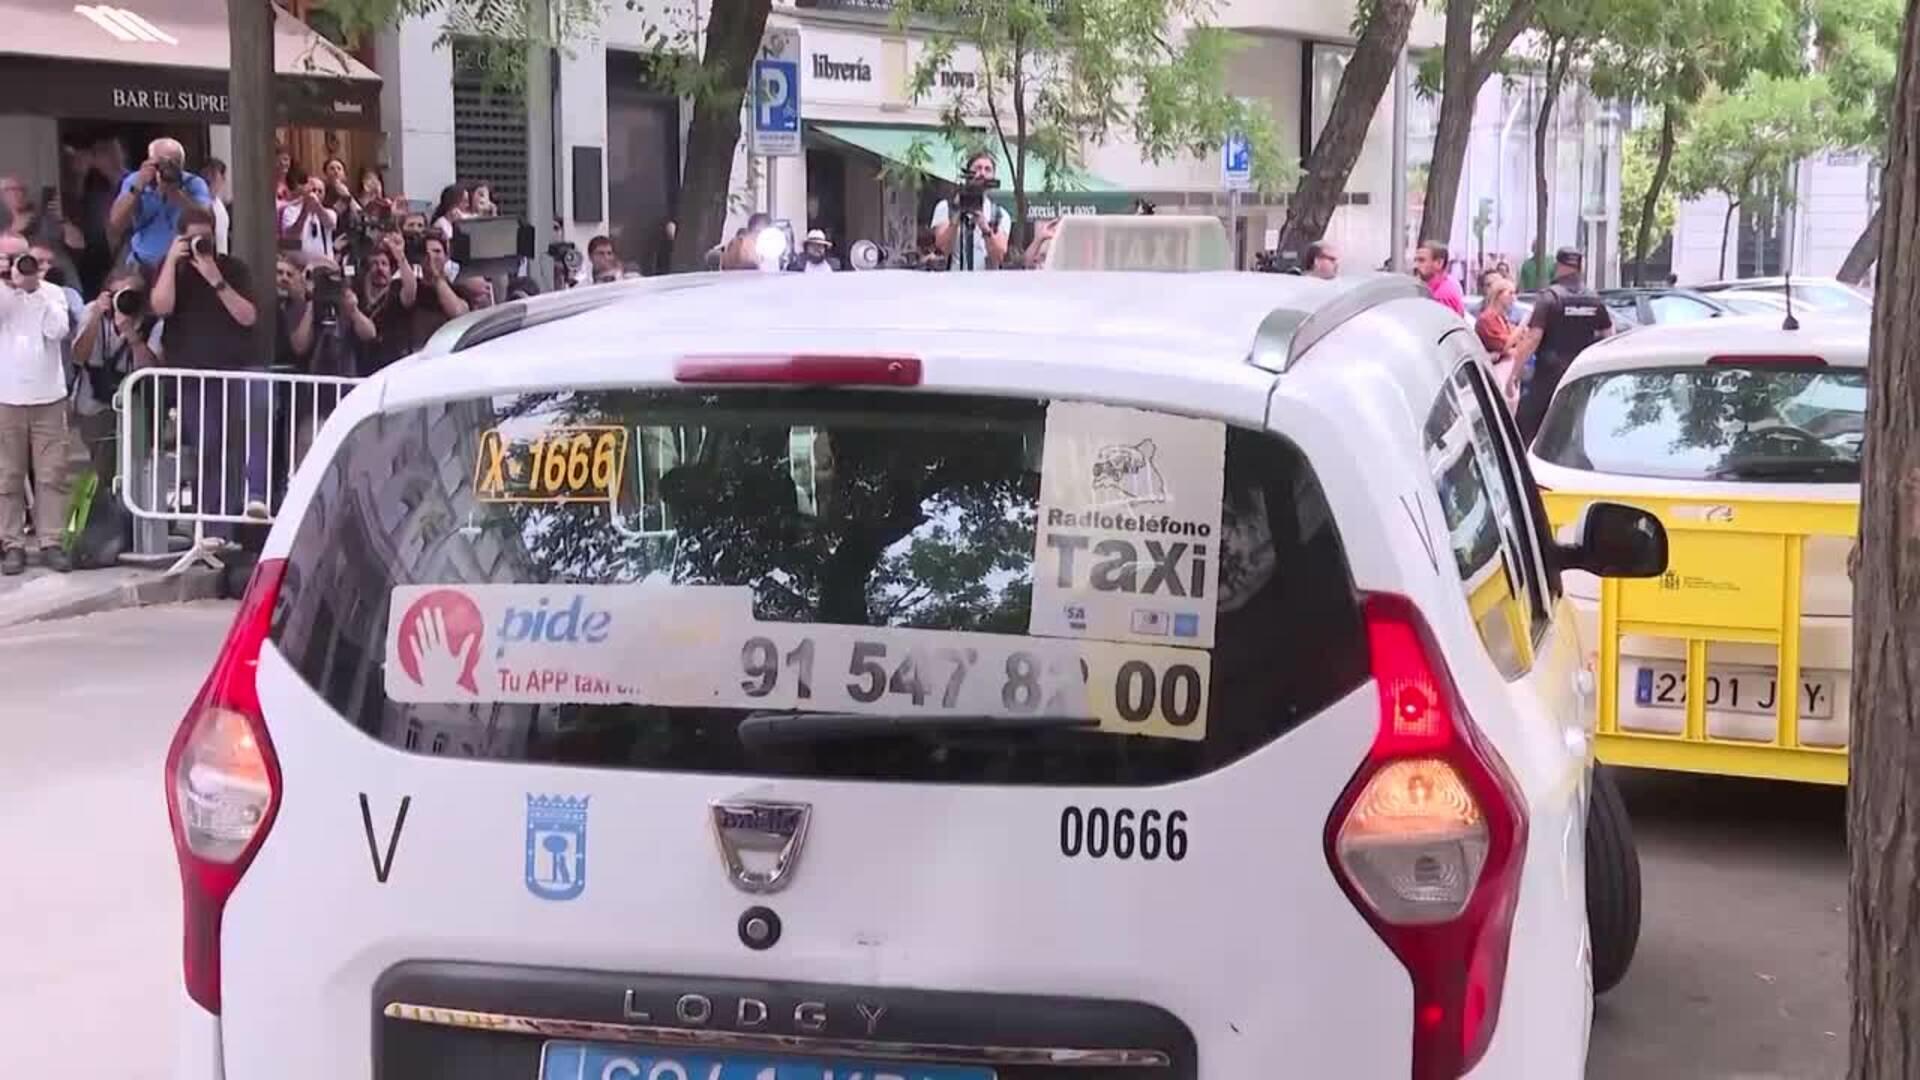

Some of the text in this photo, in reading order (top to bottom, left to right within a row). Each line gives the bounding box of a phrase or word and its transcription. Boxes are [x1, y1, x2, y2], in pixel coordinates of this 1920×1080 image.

[812, 53, 872, 82] librería
[113, 88, 229, 112] BAR EL SUPRE
[761, 67, 788, 126] P
[1110, 231, 1186, 268] TAXI
[479, 432, 616, 493] X 1666
[1047, 508, 1211, 537] Radioteléfono
[1047, 534, 1207, 599] Taxi
[499, 669, 520, 691] Tu
[526, 670, 569, 693] APP
[740, 636, 816, 700] 91
[846, 641, 979, 710] 547
[1114, 660, 1201, 727] 00
[1656, 672, 1822, 713] 201 JY
[358, 791, 412, 883] V
[1060, 805, 1188, 862] 00666
[623, 989, 887, 1034] LODGY
